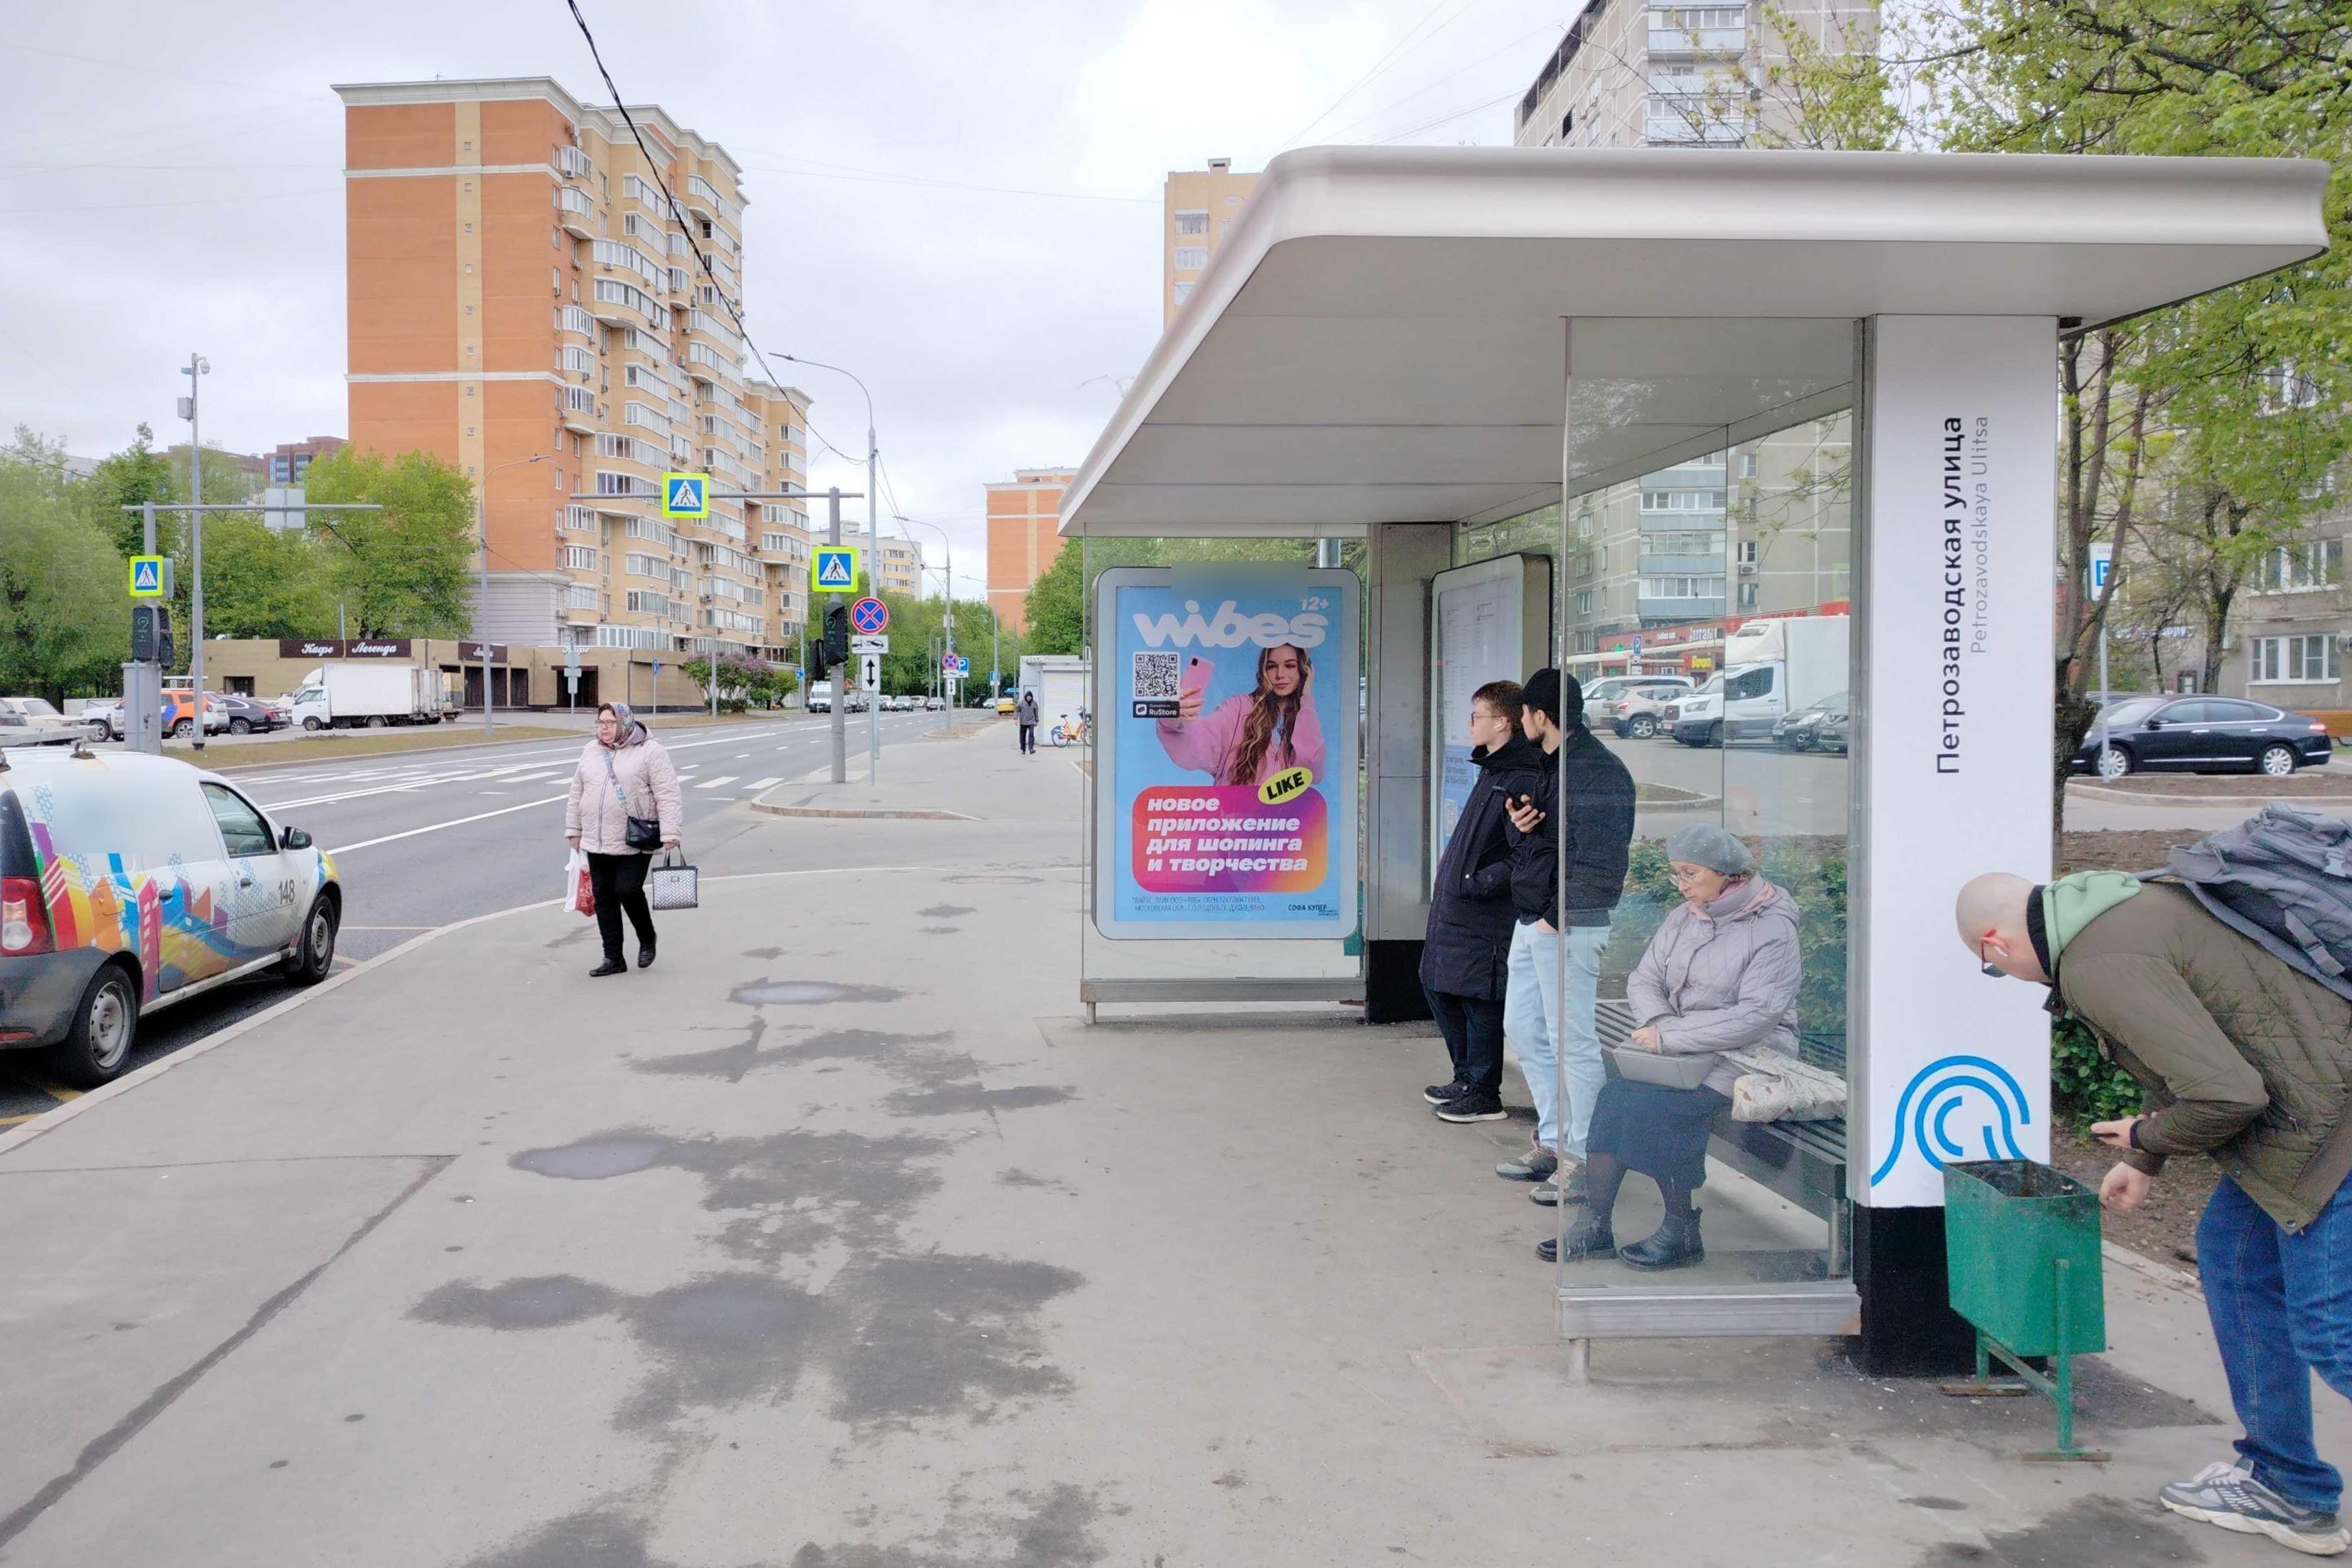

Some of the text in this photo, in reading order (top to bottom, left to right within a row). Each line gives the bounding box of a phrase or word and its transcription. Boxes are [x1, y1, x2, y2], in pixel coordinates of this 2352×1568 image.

[1970, 416, 1991, 653] Petrozavodskaya Ulitsa
[1300, 596, 1329, 610] 12+
[1937, 417, 1967, 773] Петрозаводская улица
[1132, 600, 1328, 648] wibes
[301, 642, 397, 657] Кафе Легенда
[1267, 771, 1305, 800] LIKE
[1147, 798, 1220, 811] новое
[1147, 817, 1301, 836] приложение
[1146, 838, 1303, 854] для шопинга
[1147, 858, 1308, 876] и творчества
[278, 879, 295, 904] 148
